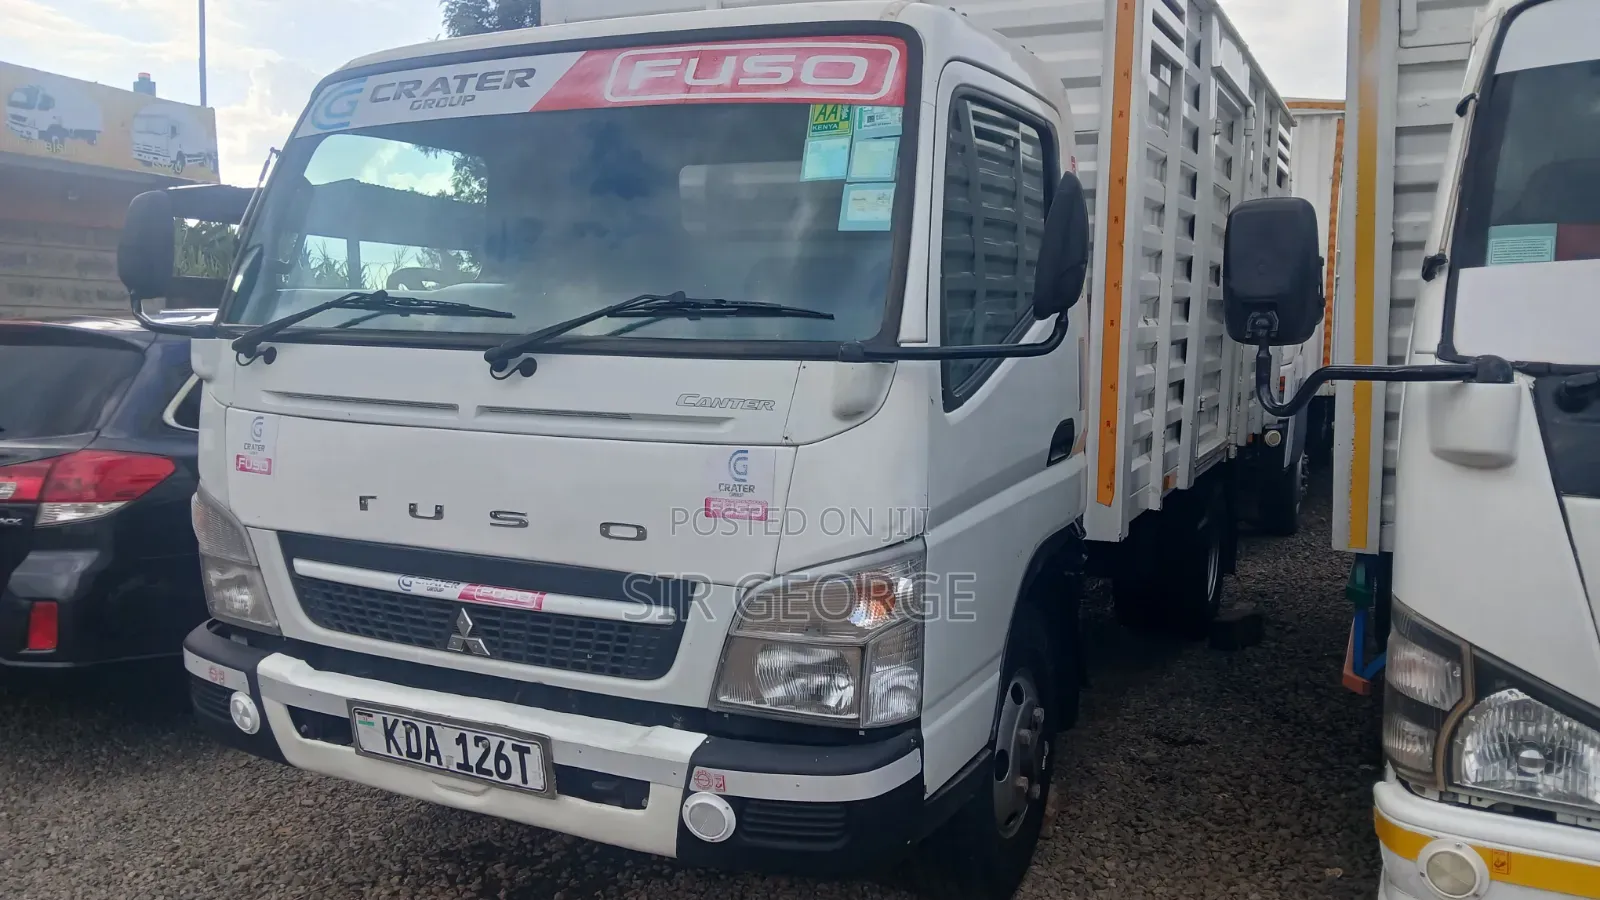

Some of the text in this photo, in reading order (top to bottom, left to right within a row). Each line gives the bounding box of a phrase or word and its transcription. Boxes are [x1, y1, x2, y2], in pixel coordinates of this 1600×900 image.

[628, 54, 869, 90] FUSO
[368, 67, 537, 104] CRATER
[409, 94, 476, 111] GROUP
[812, 123, 838, 131] KENYA
[675, 393, 776, 412] CANTER
[243, 442, 266, 452] CRATER
[238, 457, 269, 472] FUSO
[718, 482, 756, 494] CRATER
[382, 716, 443, 766] KDA
[455, 732, 531, 785] 126T
